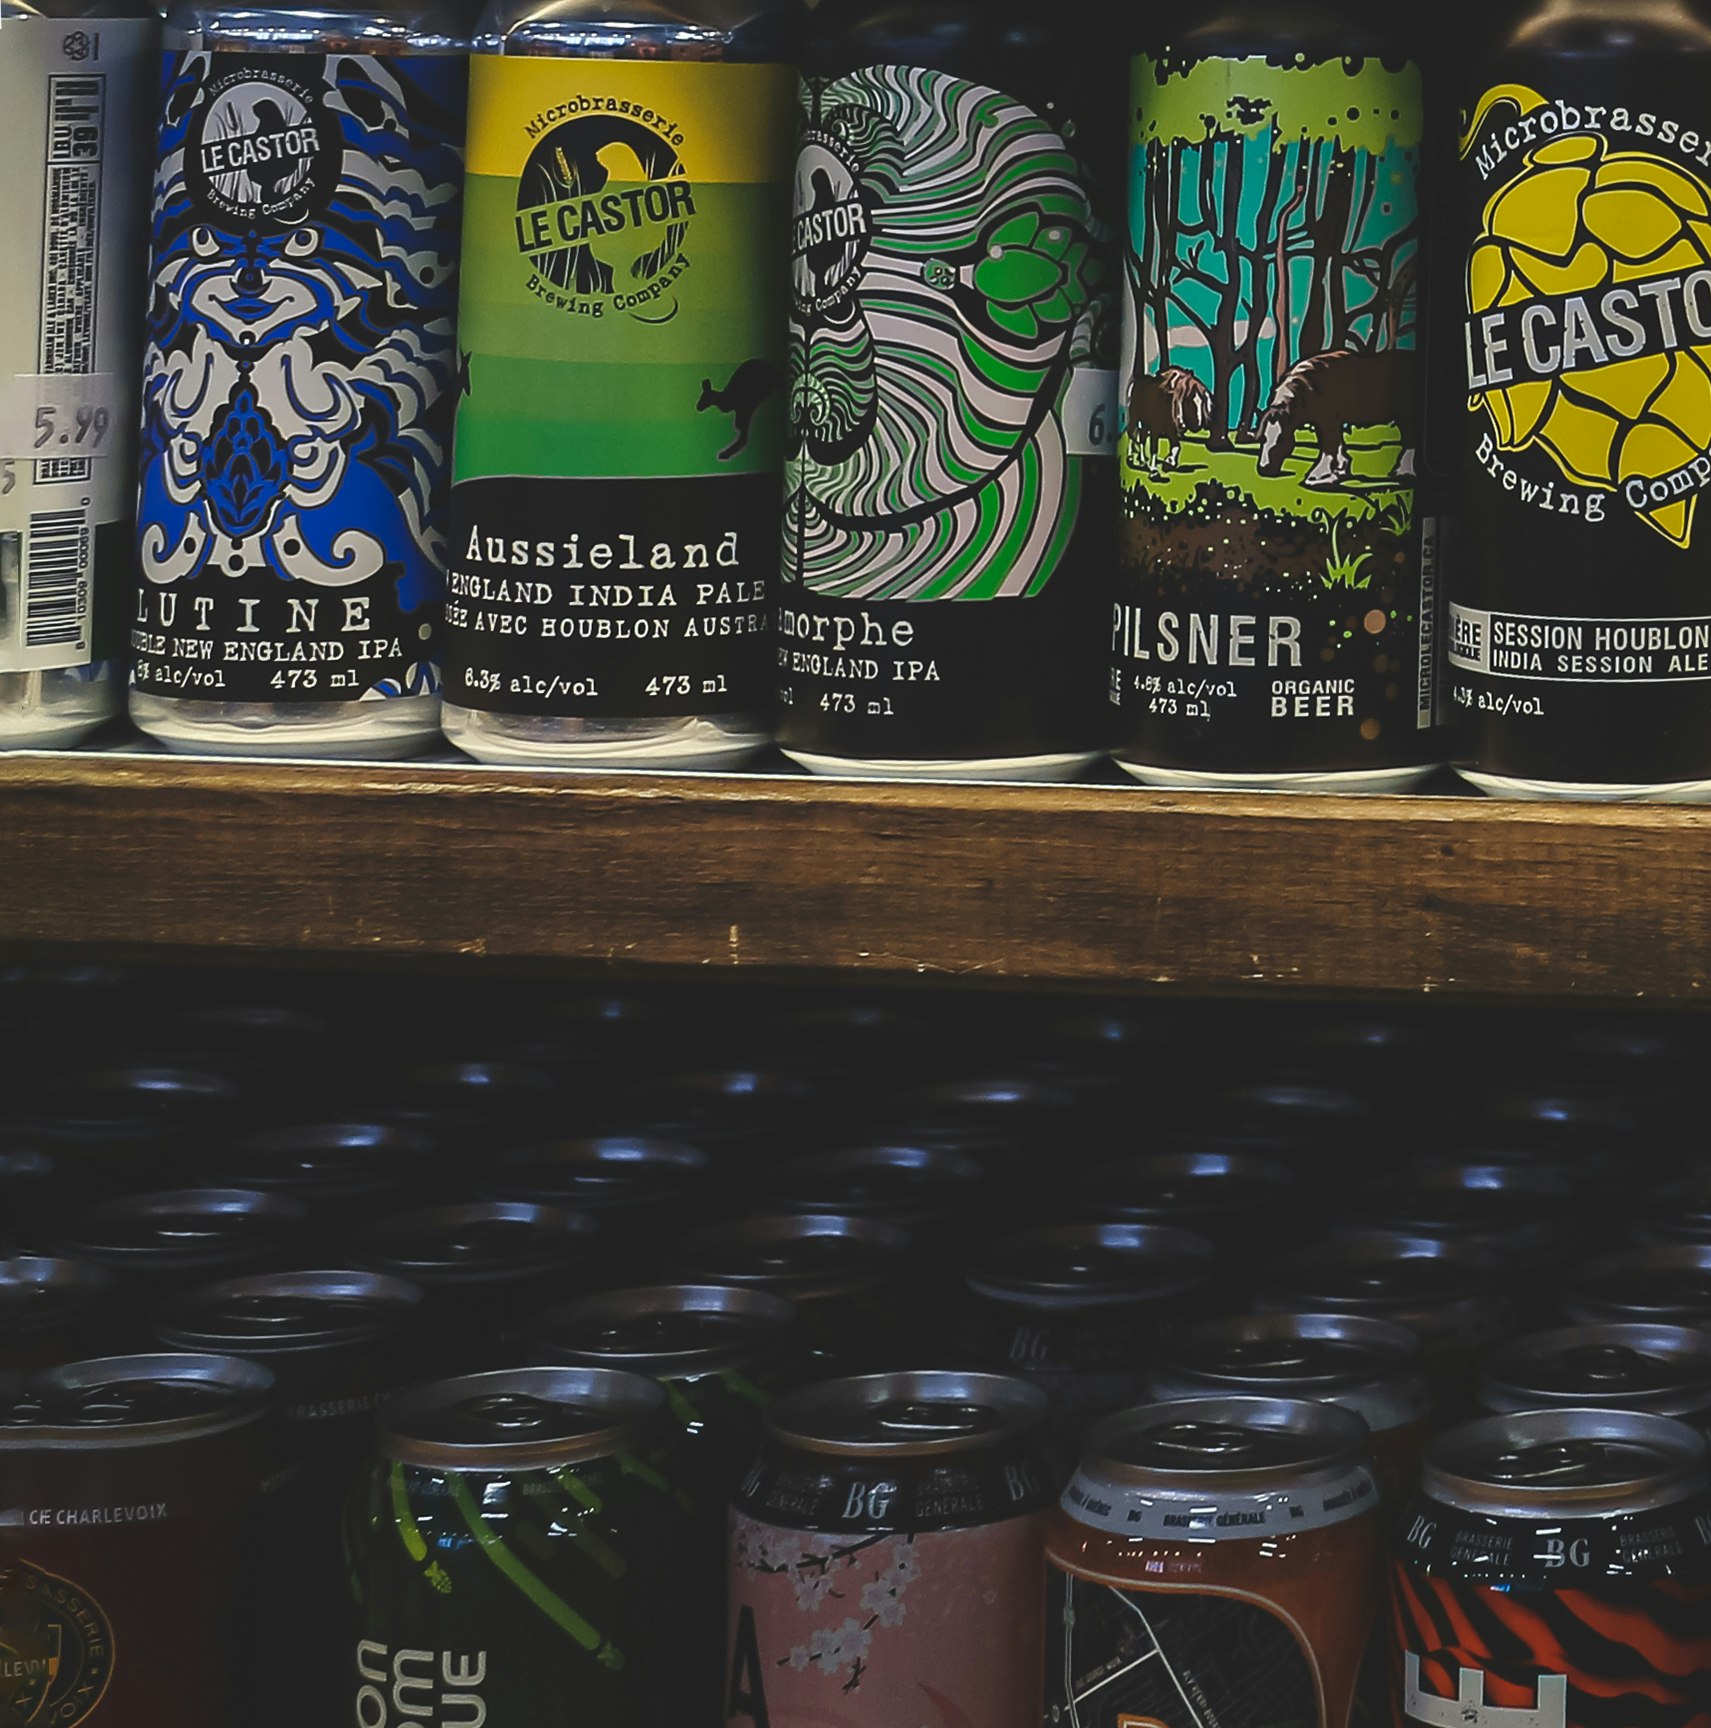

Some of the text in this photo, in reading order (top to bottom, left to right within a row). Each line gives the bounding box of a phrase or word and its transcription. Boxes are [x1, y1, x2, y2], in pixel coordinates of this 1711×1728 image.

[226, 128, 321, 168] CASTOR
[514, 180, 698, 254] LE CASTOR
[795, 201, 867, 251] CASTOR
[1464, 311, 1514, 390] LE
[32, 404, 112, 452] 5.99
[465, 524, 740, 571] Aussieland
[568, 579, 767, 608] INDIA PALE
[137, 588, 371, 634] LUTINE
[474, 615, 672, 639] AVEC HOUBLON
[1111, 601, 1303, 668] PILSNER
[1493, 621, 1711, 652] SESSION HOUBLON
[223, 637, 404, 663] ENGLAND IPA
[1492, 648, 1709, 673] INDIA SESSION ALE
[270, 670, 318, 690] 473
[509, 674, 692, 699] alc/vol 473
[892, 659, 941, 683] IPA
[1271, 678, 1356, 695] ORGANIC
[1271, 694, 1355, 718] BEER
[1478, 691, 1545, 716] alc/vol
[55, 1502, 168, 1526] CHARLEVOIX
[841, 1482, 897, 1520] BG
[1406, 1514, 1438, 1550] BG
[1545, 1537, 1591, 1569] BG
